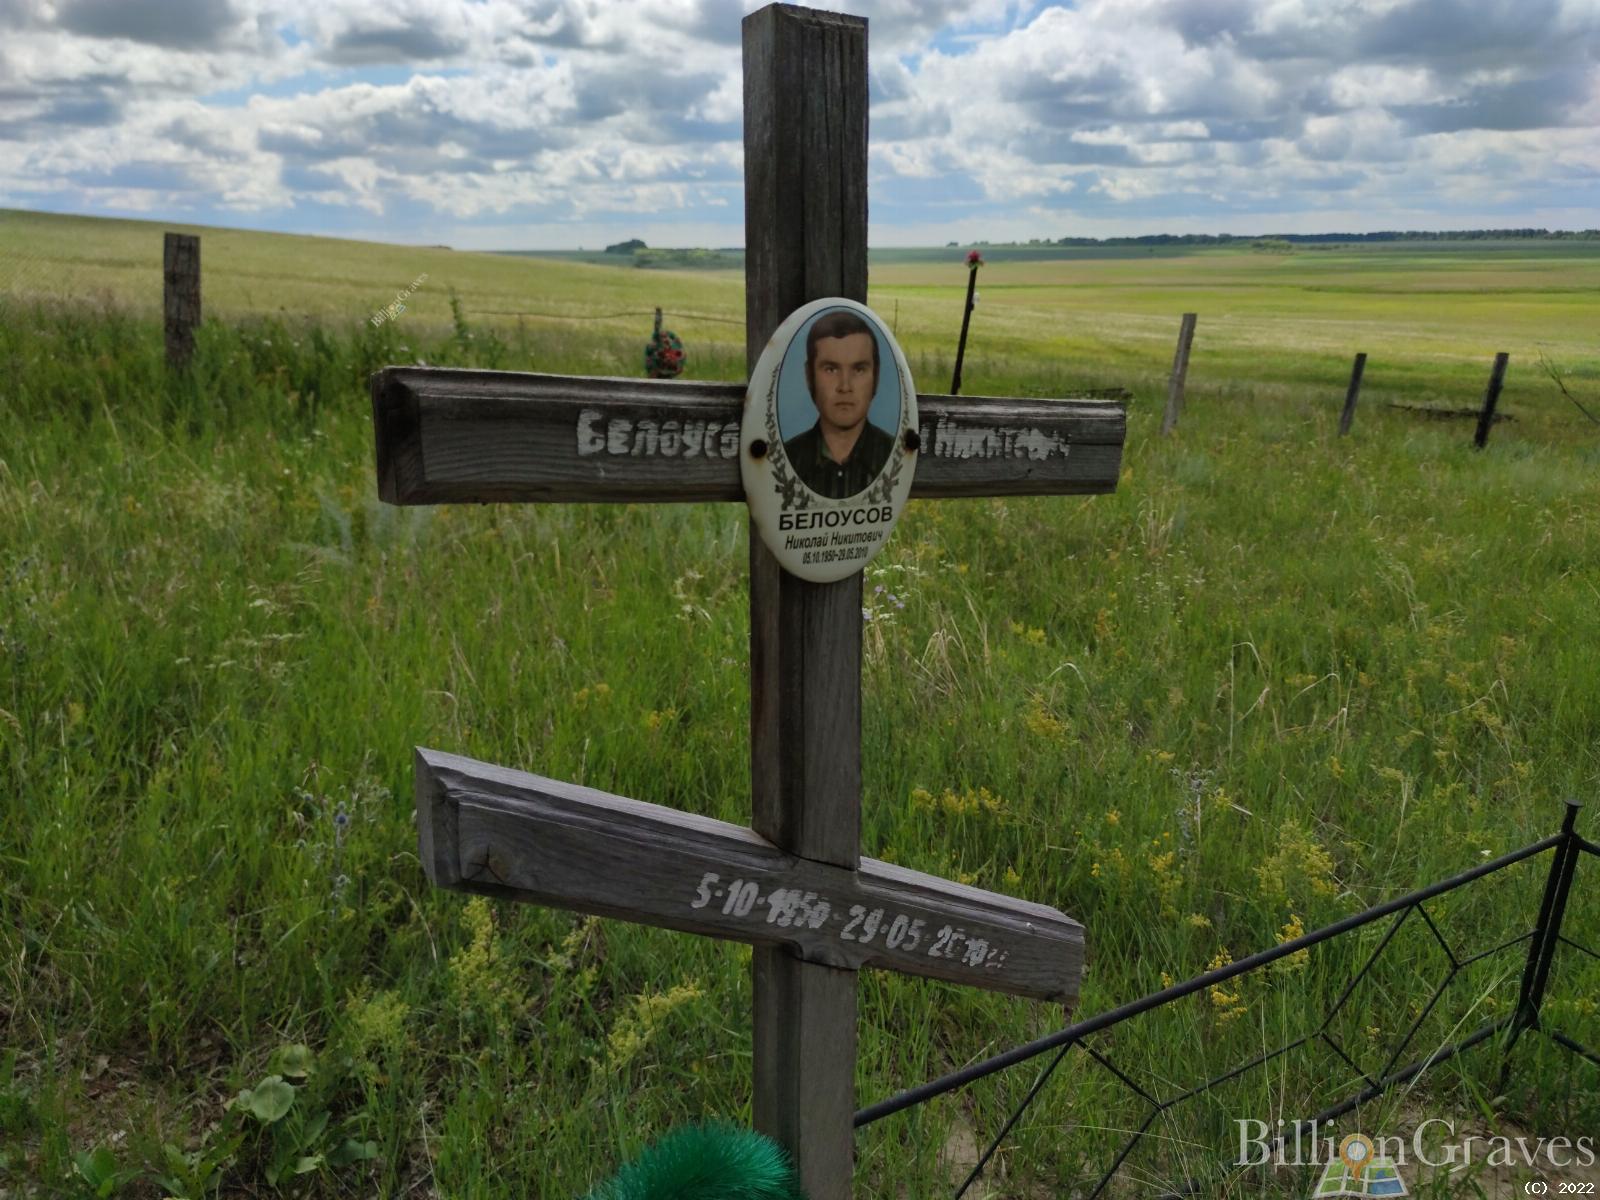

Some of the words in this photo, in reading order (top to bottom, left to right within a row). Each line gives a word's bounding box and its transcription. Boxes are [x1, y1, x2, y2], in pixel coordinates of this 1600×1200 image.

[779, 506, 893, 531] БЕЛОУСОВ
[785, 532, 829, 550] Николай
[830, 530, 883, 546] Никитович
